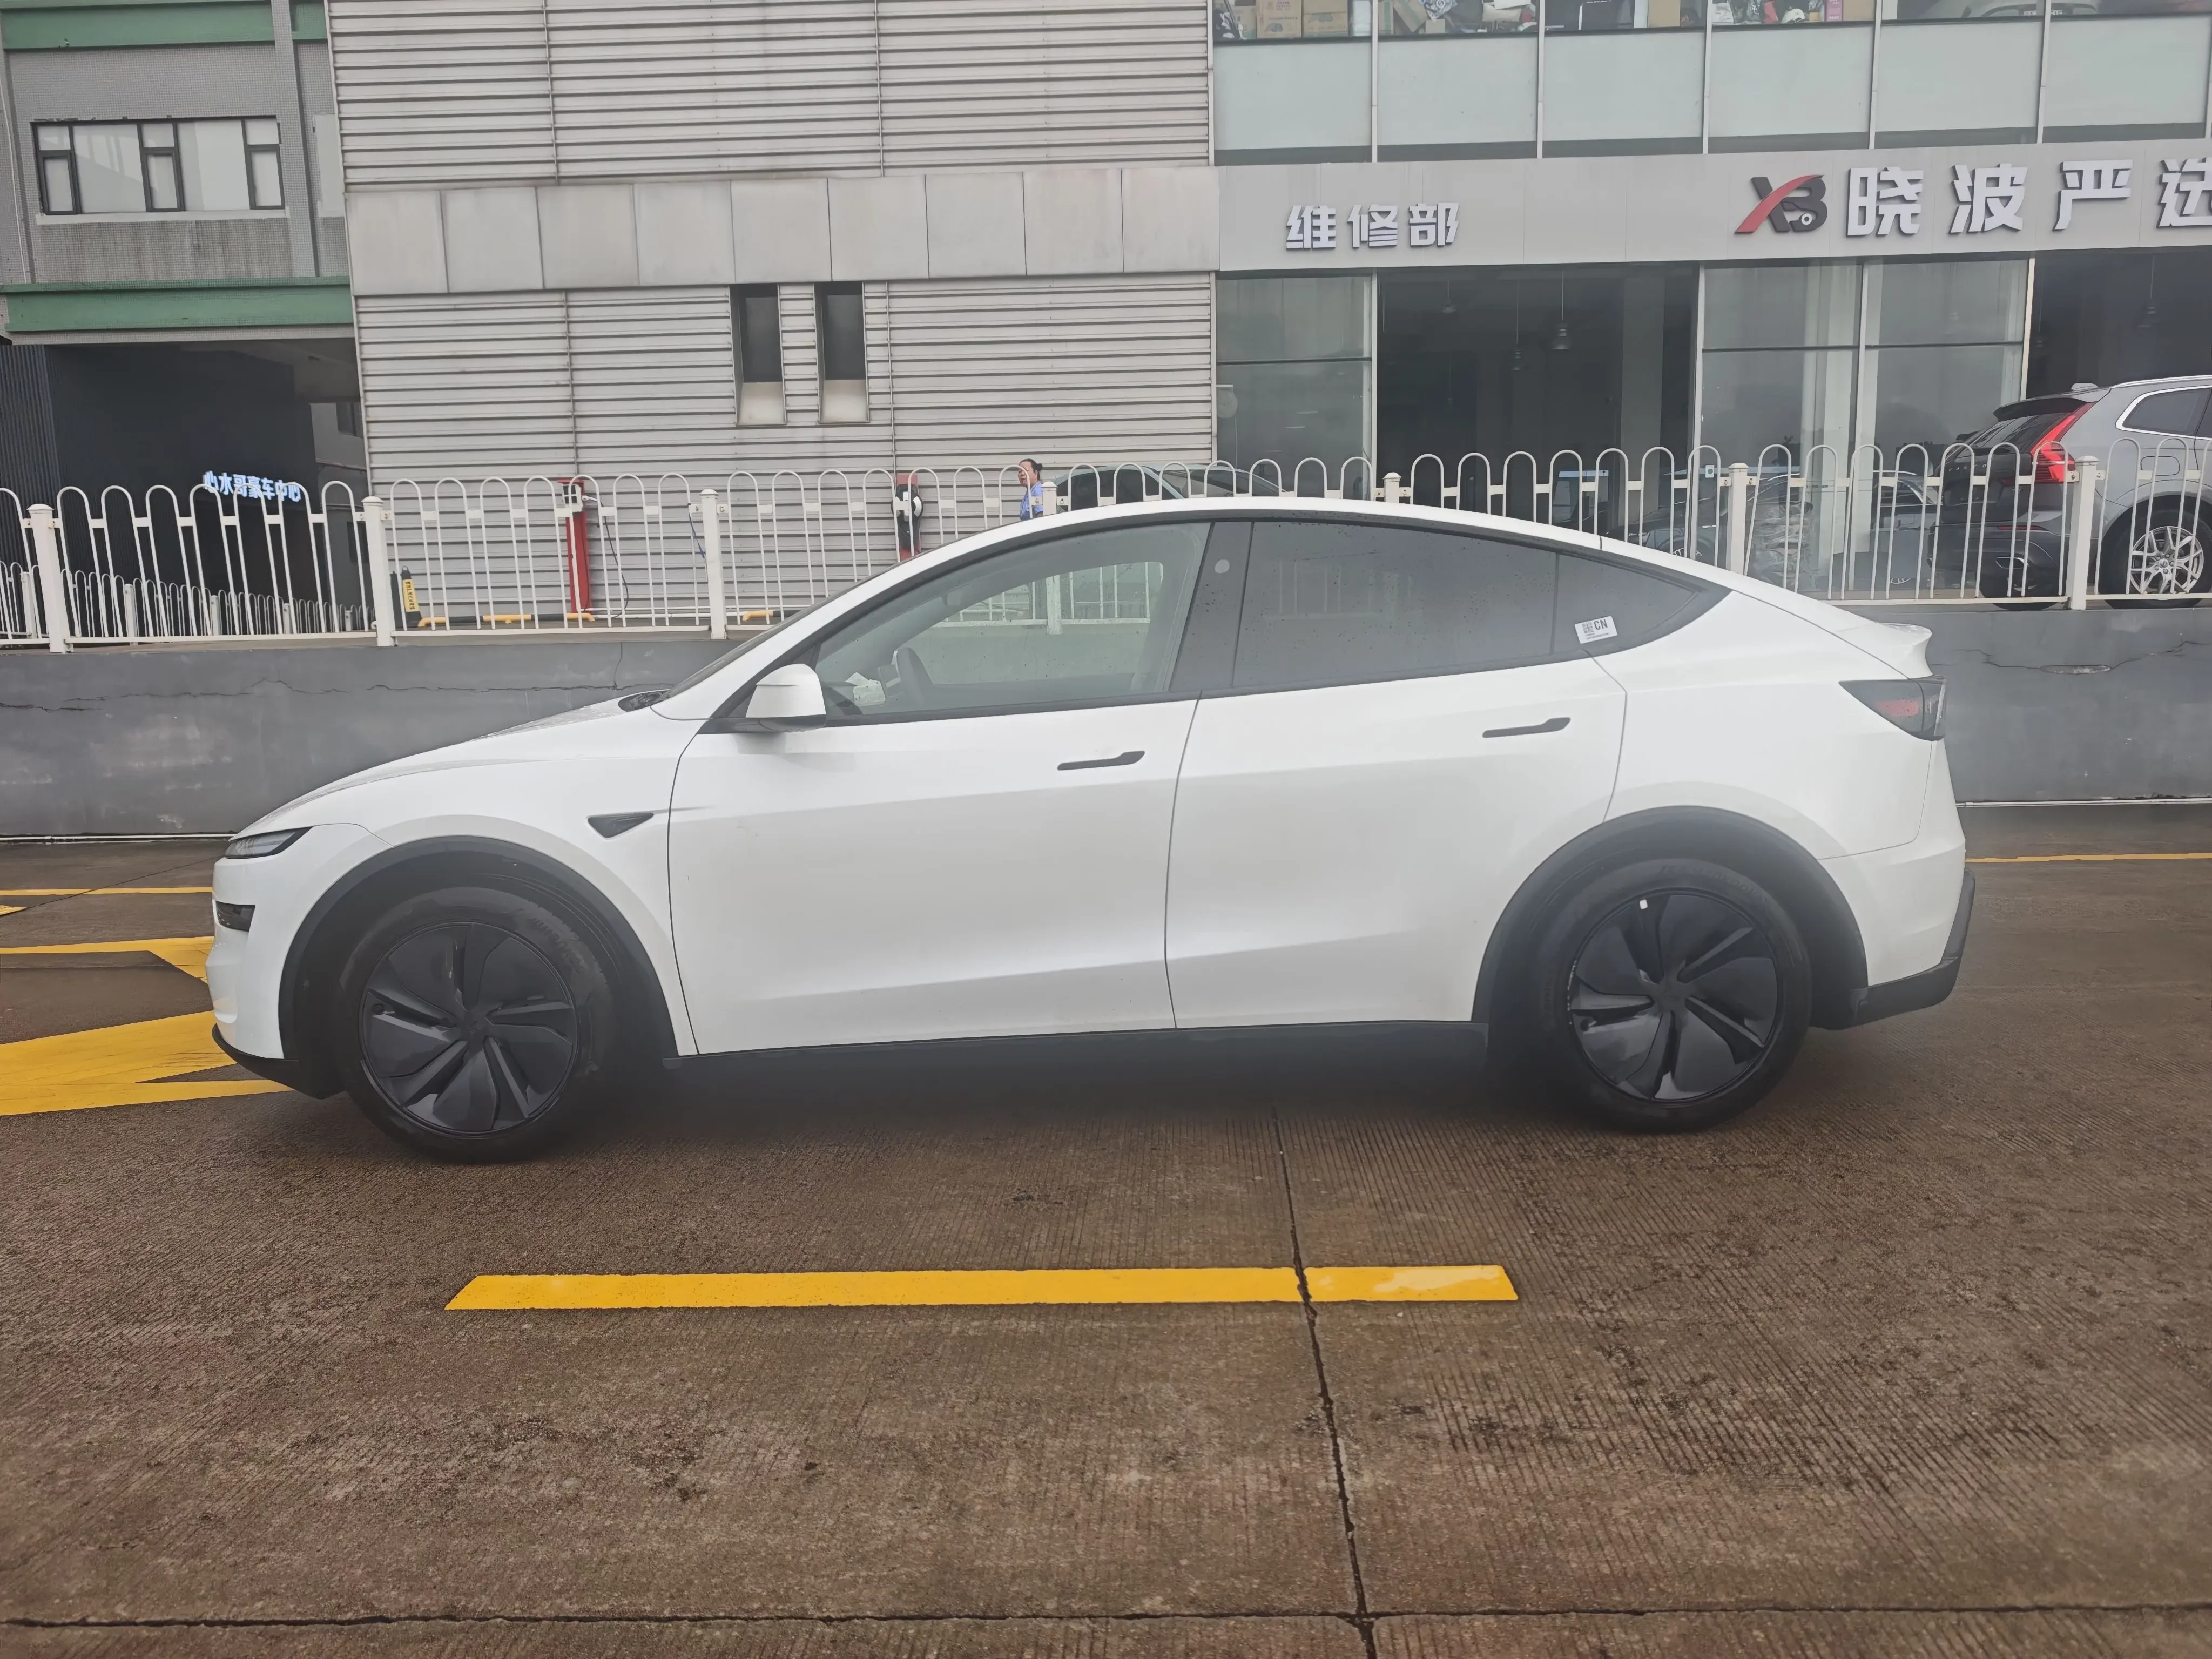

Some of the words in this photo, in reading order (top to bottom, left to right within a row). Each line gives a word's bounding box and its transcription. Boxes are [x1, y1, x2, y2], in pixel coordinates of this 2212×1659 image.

[1846, 157, 2212, 236] 晓波严选
[1286, 202, 1460, 250] 维修部
[1594, 619, 1608, 630] CN
